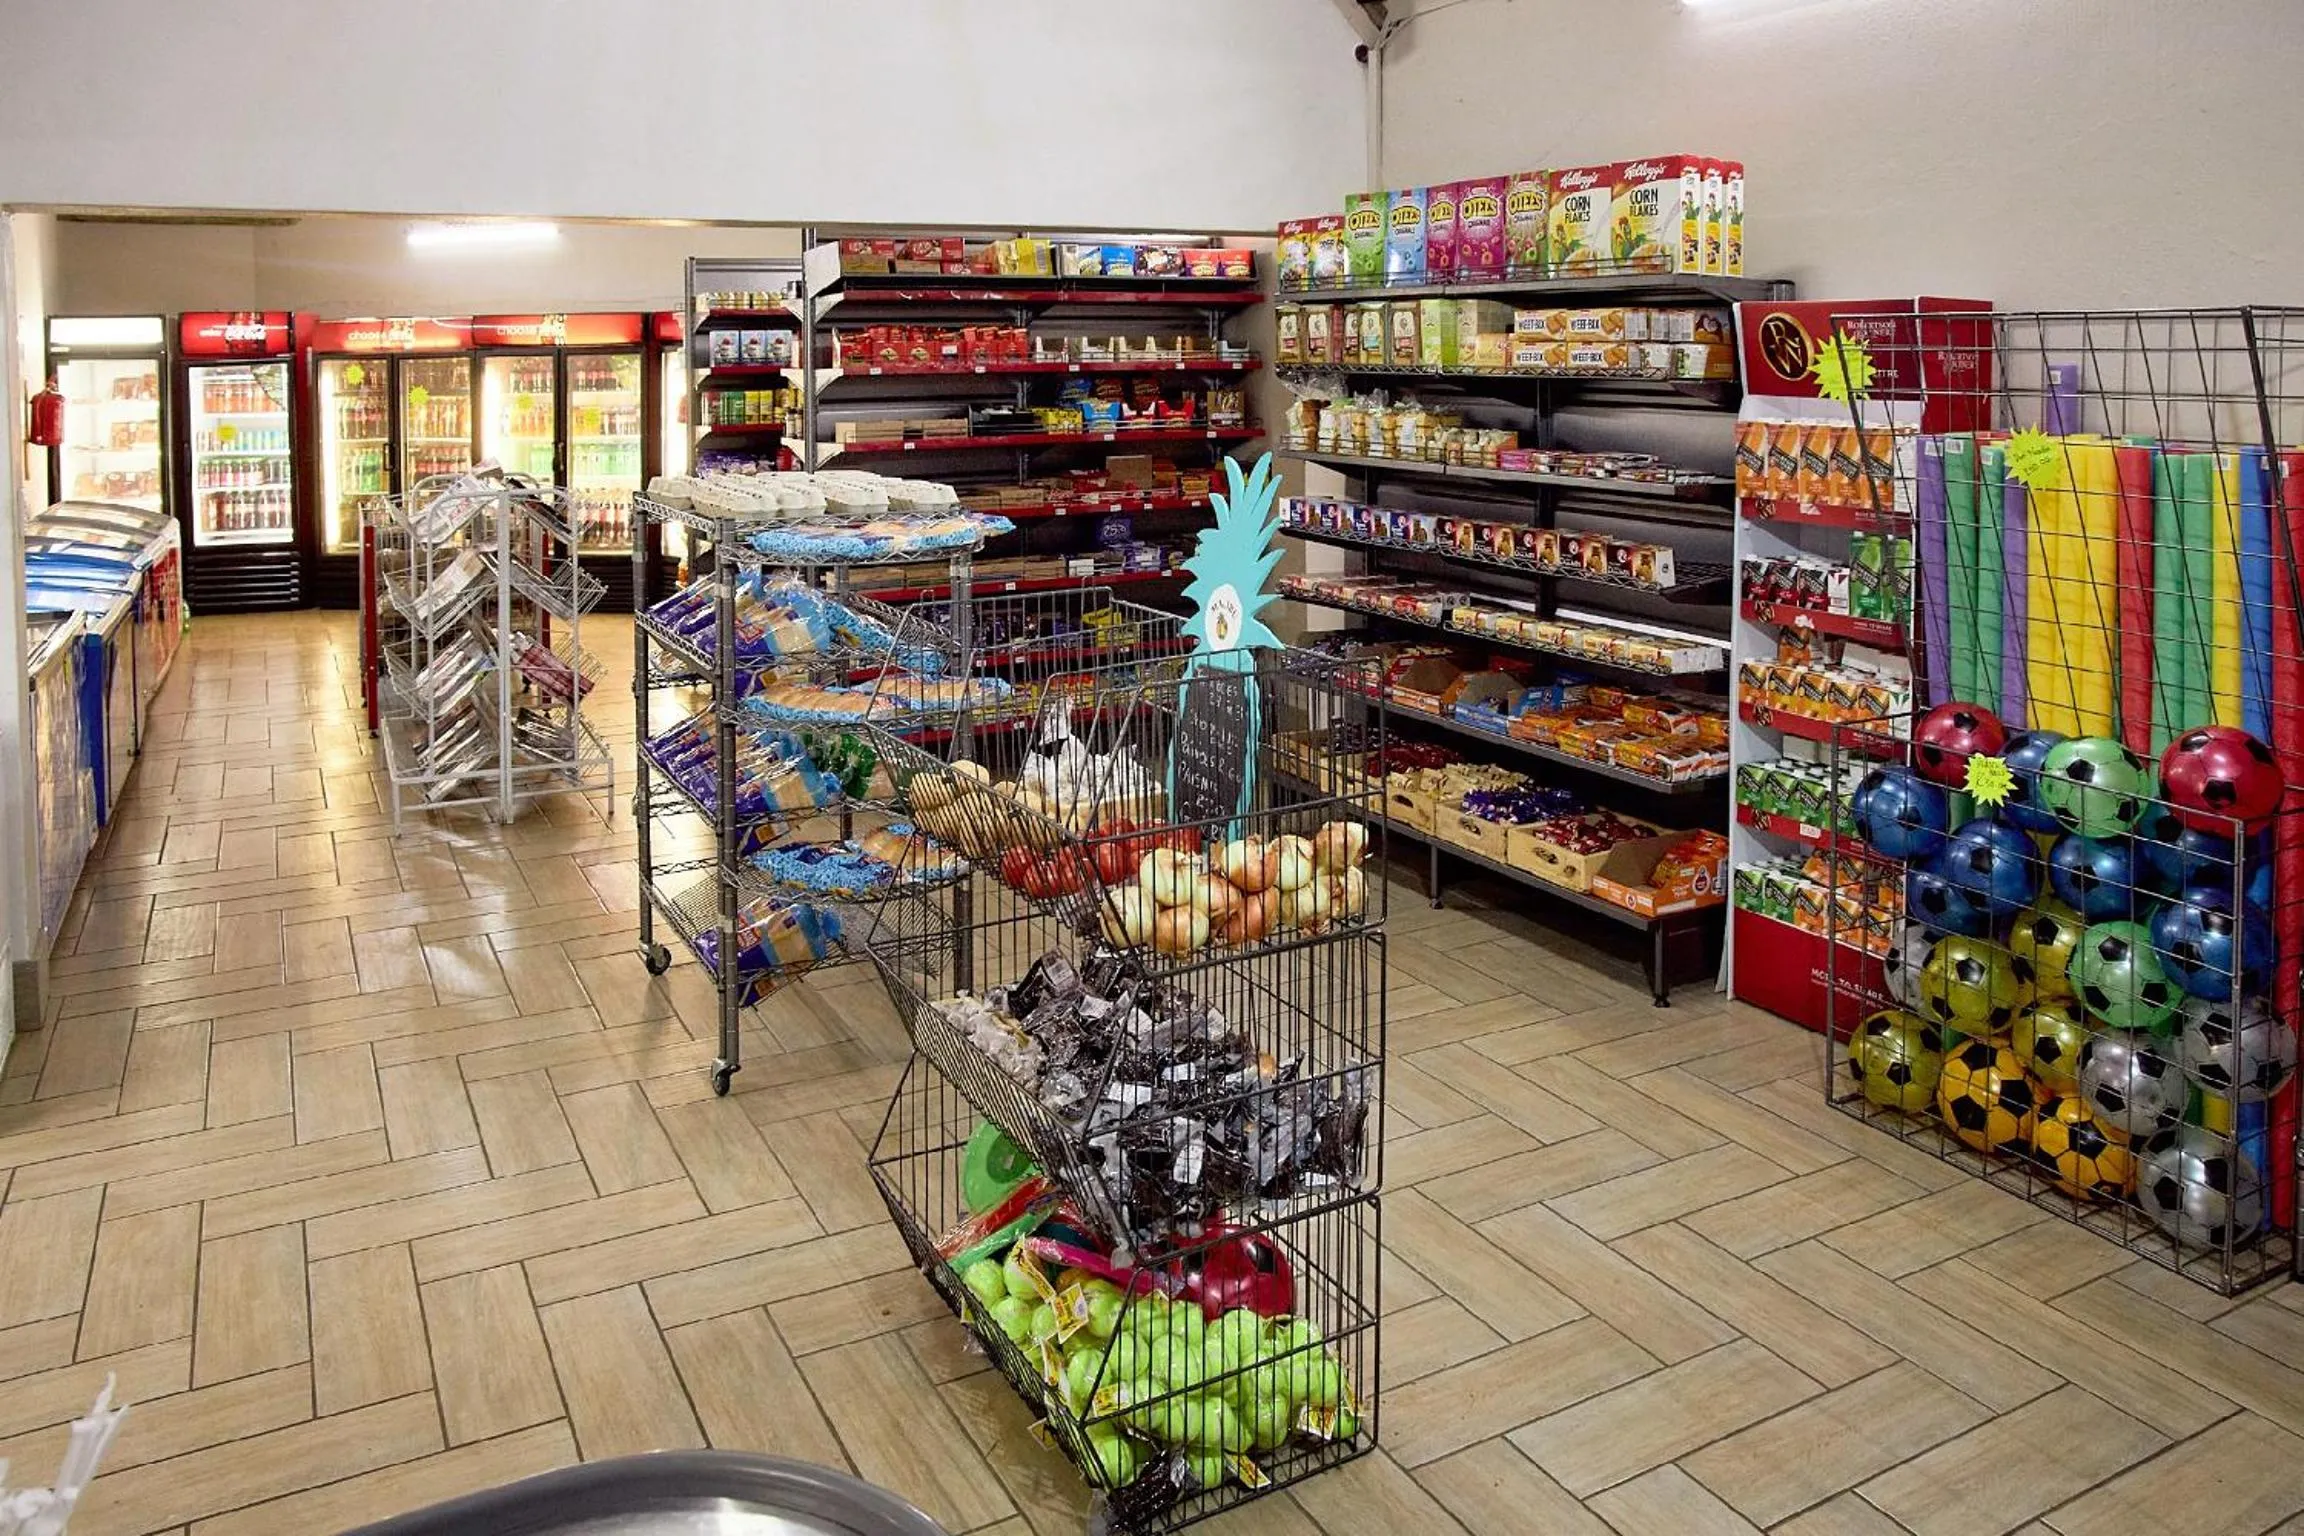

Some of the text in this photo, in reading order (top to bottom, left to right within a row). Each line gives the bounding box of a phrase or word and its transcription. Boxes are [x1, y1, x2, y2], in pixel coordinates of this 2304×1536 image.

[1559, 170, 1599, 189] Kellogg's
[1623, 162, 1667, 182] Kellogg's
[1564, 195, 1591, 213] CORN
[1629, 187, 1659, 206] CORN
[1391, 206, 1421, 226] OTEES
[1462, 197, 1498, 217] OTEES
[1629, 204, 1659, 217] FLAKES
[1349, 211, 1381, 229] OTEES
[1564, 212, 1591, 224] FLAKES
